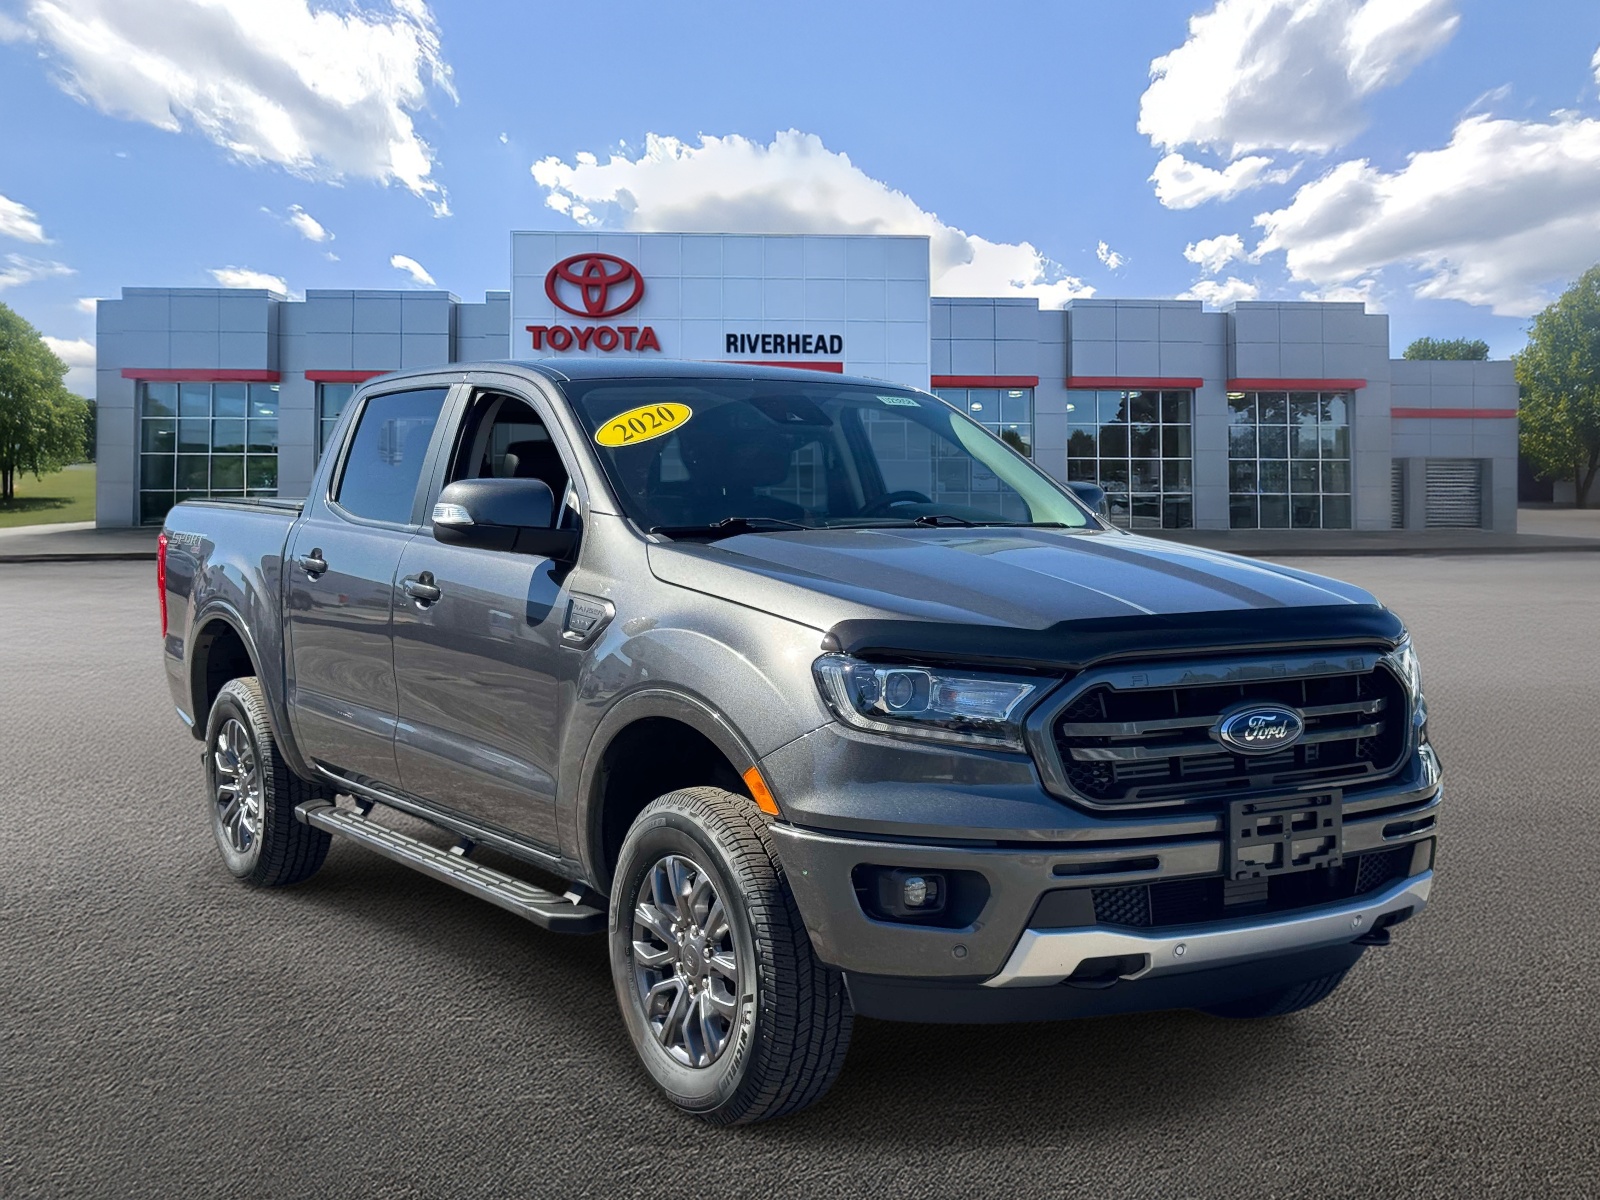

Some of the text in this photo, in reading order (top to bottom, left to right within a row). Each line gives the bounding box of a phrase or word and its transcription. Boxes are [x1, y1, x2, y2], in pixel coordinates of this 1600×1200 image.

[526, 325, 661, 352] TOYOTA
[726, 333, 843, 354] RIVERHEAD
[612, 405, 677, 442] 2020
[1244, 715, 1288, 741] Ford
